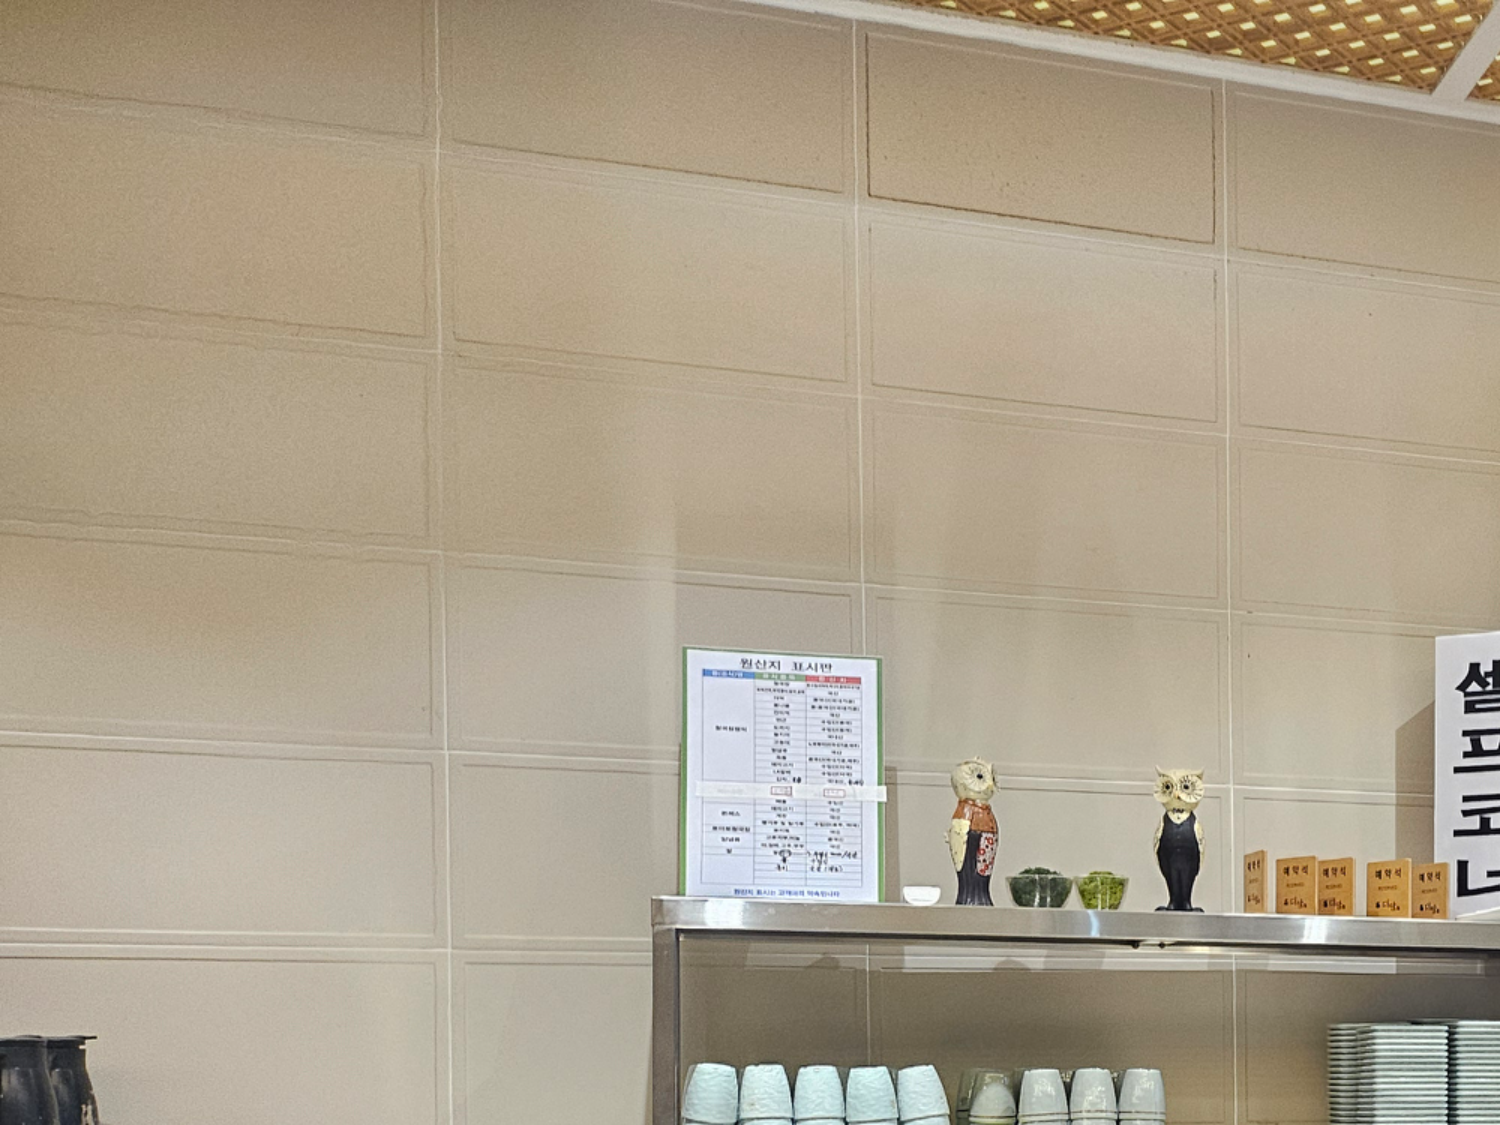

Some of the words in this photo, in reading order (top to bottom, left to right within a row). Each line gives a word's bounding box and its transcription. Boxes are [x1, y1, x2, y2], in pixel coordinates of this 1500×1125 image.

[740, 658, 781, 672] 원산지
[791, 661, 833, 673] 표시판
[1283, 865, 1309, 877] 예약석
[1375, 867, 1402, 880] 예약석
